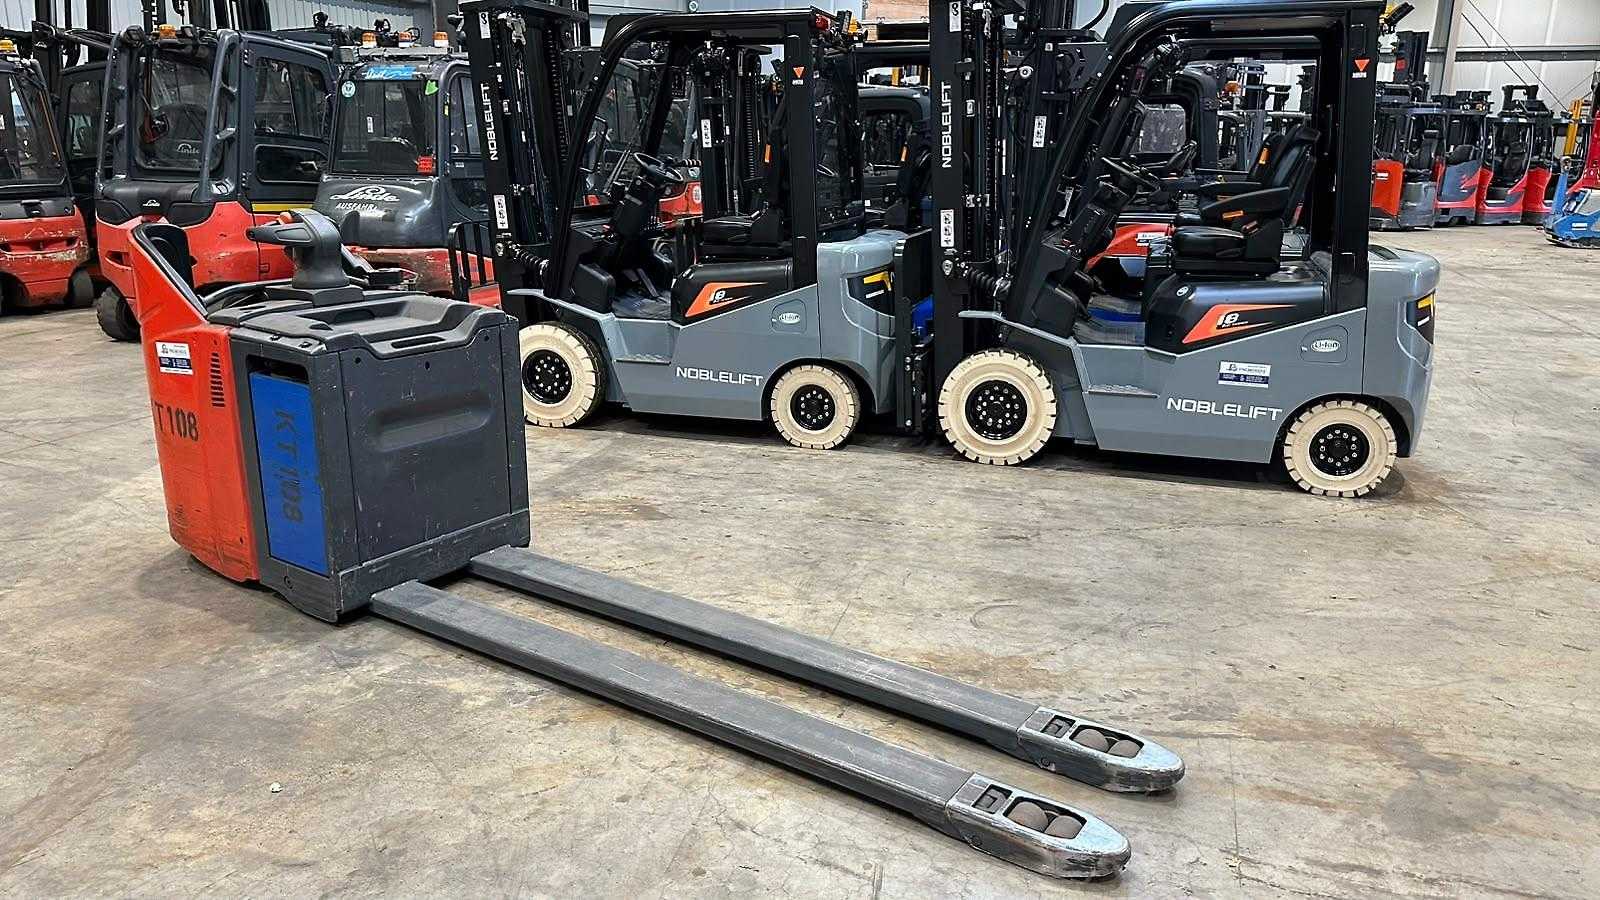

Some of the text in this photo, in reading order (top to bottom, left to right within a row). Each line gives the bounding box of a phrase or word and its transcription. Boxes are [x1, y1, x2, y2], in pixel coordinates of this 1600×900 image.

[480, 83, 499, 160] NOBLELIFT
[941, 82, 952, 168] NOBLELIFT
[330, 185, 400, 202] Linde
[676, 366, 763, 386] NOBLELIFT
[1166, 397, 1283, 421] NOBLELIFT
